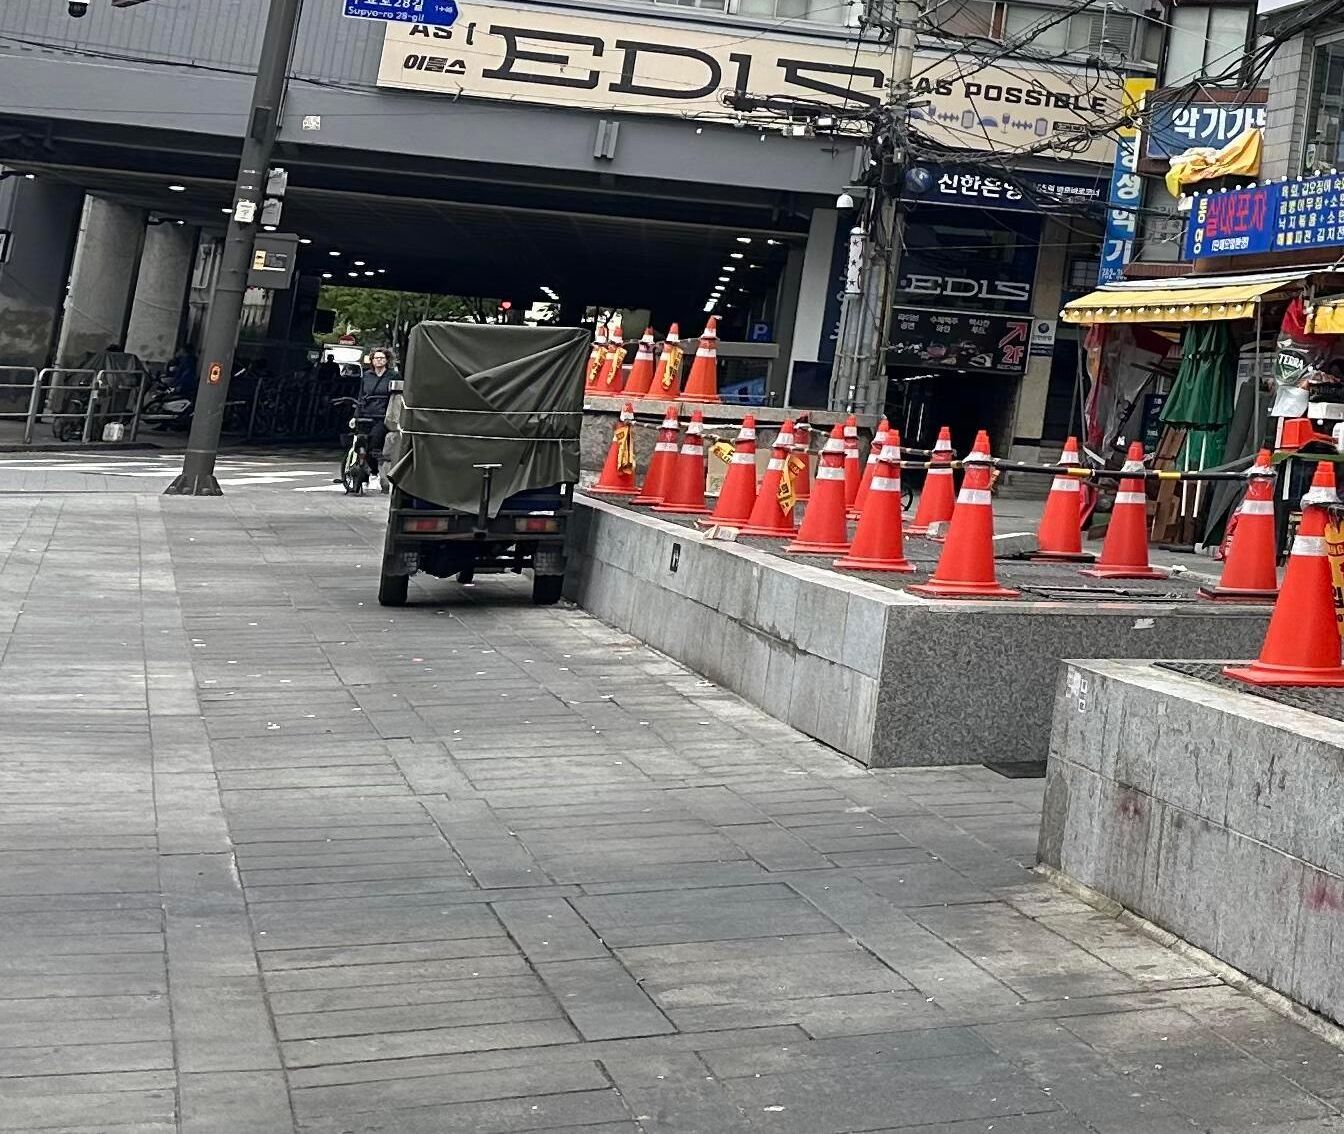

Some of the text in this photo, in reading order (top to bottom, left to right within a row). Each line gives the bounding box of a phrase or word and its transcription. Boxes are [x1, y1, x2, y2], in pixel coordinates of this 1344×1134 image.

[347, 5, 425, 23] Supyo-ro 28-gil
[964, 82, 1108, 114] POSSIBLE
[1193, 197, 1209, 255] 통영
[1205, 190, 1267, 239] 실내포차
[904, 273, 1030, 302] EDIS
[1001, 344, 1025, 365] 2F
